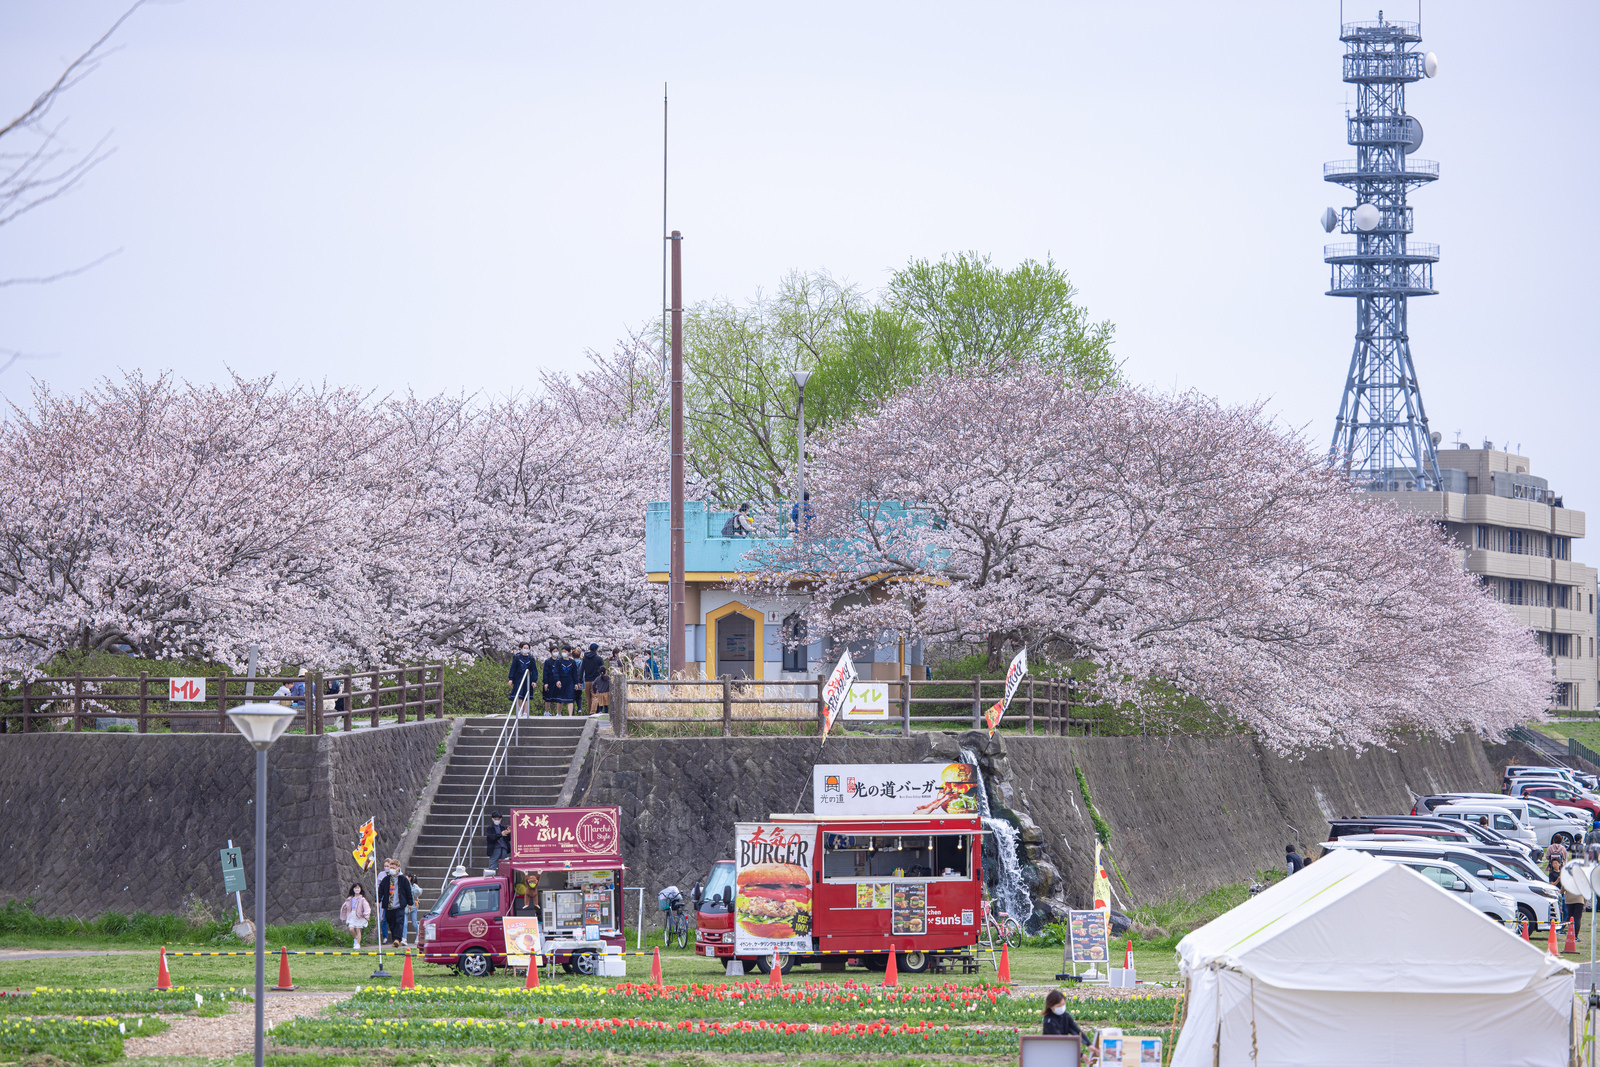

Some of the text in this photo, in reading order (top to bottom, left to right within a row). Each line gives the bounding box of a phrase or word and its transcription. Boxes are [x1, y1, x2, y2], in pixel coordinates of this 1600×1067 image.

[171, 680, 200, 699] トイレ
[849, 688, 882, 703] トイレ
[851, 779, 944, 798] 光の道バーガー
[820, 794, 845, 804] 光の道
[536, 826, 575, 842] ぷりん
[596, 832, 611, 842] Style
[748, 826, 801, 848] 本気の
[740, 839, 809, 868] BURGER
[797, 914, 810, 924] BEEF
[934, 914, 961, 925] sun's
[794, 923, 809, 933] 100%
